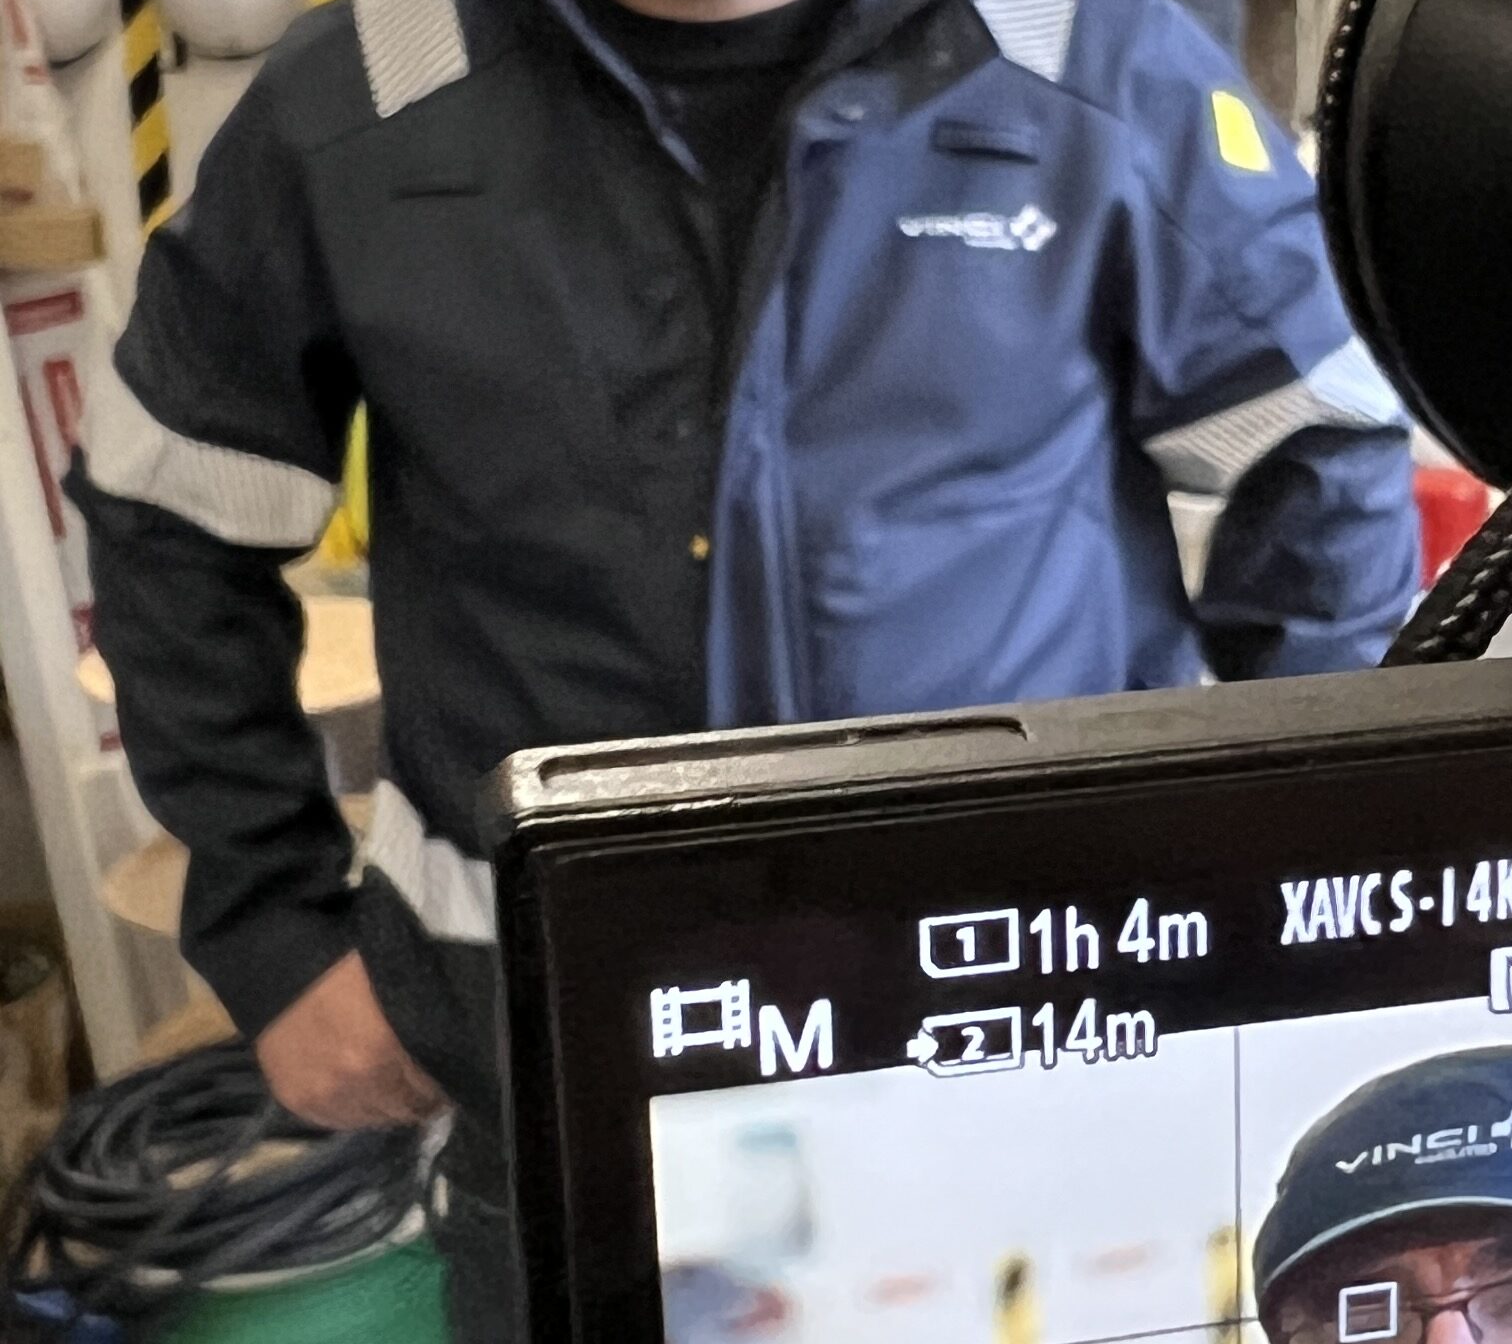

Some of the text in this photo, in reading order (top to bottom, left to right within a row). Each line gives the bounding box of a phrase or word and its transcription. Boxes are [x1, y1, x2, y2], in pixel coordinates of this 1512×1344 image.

[1029, 905, 1100, 975] 1h
[1116, 897, 1208, 963] 4m
[1280, 871, 1382, 946] XAVC
[758, 998, 834, 1077] M
[1032, 997, 1155, 1069] 14m
[1335, 1124, 1478, 1173] VINCI
